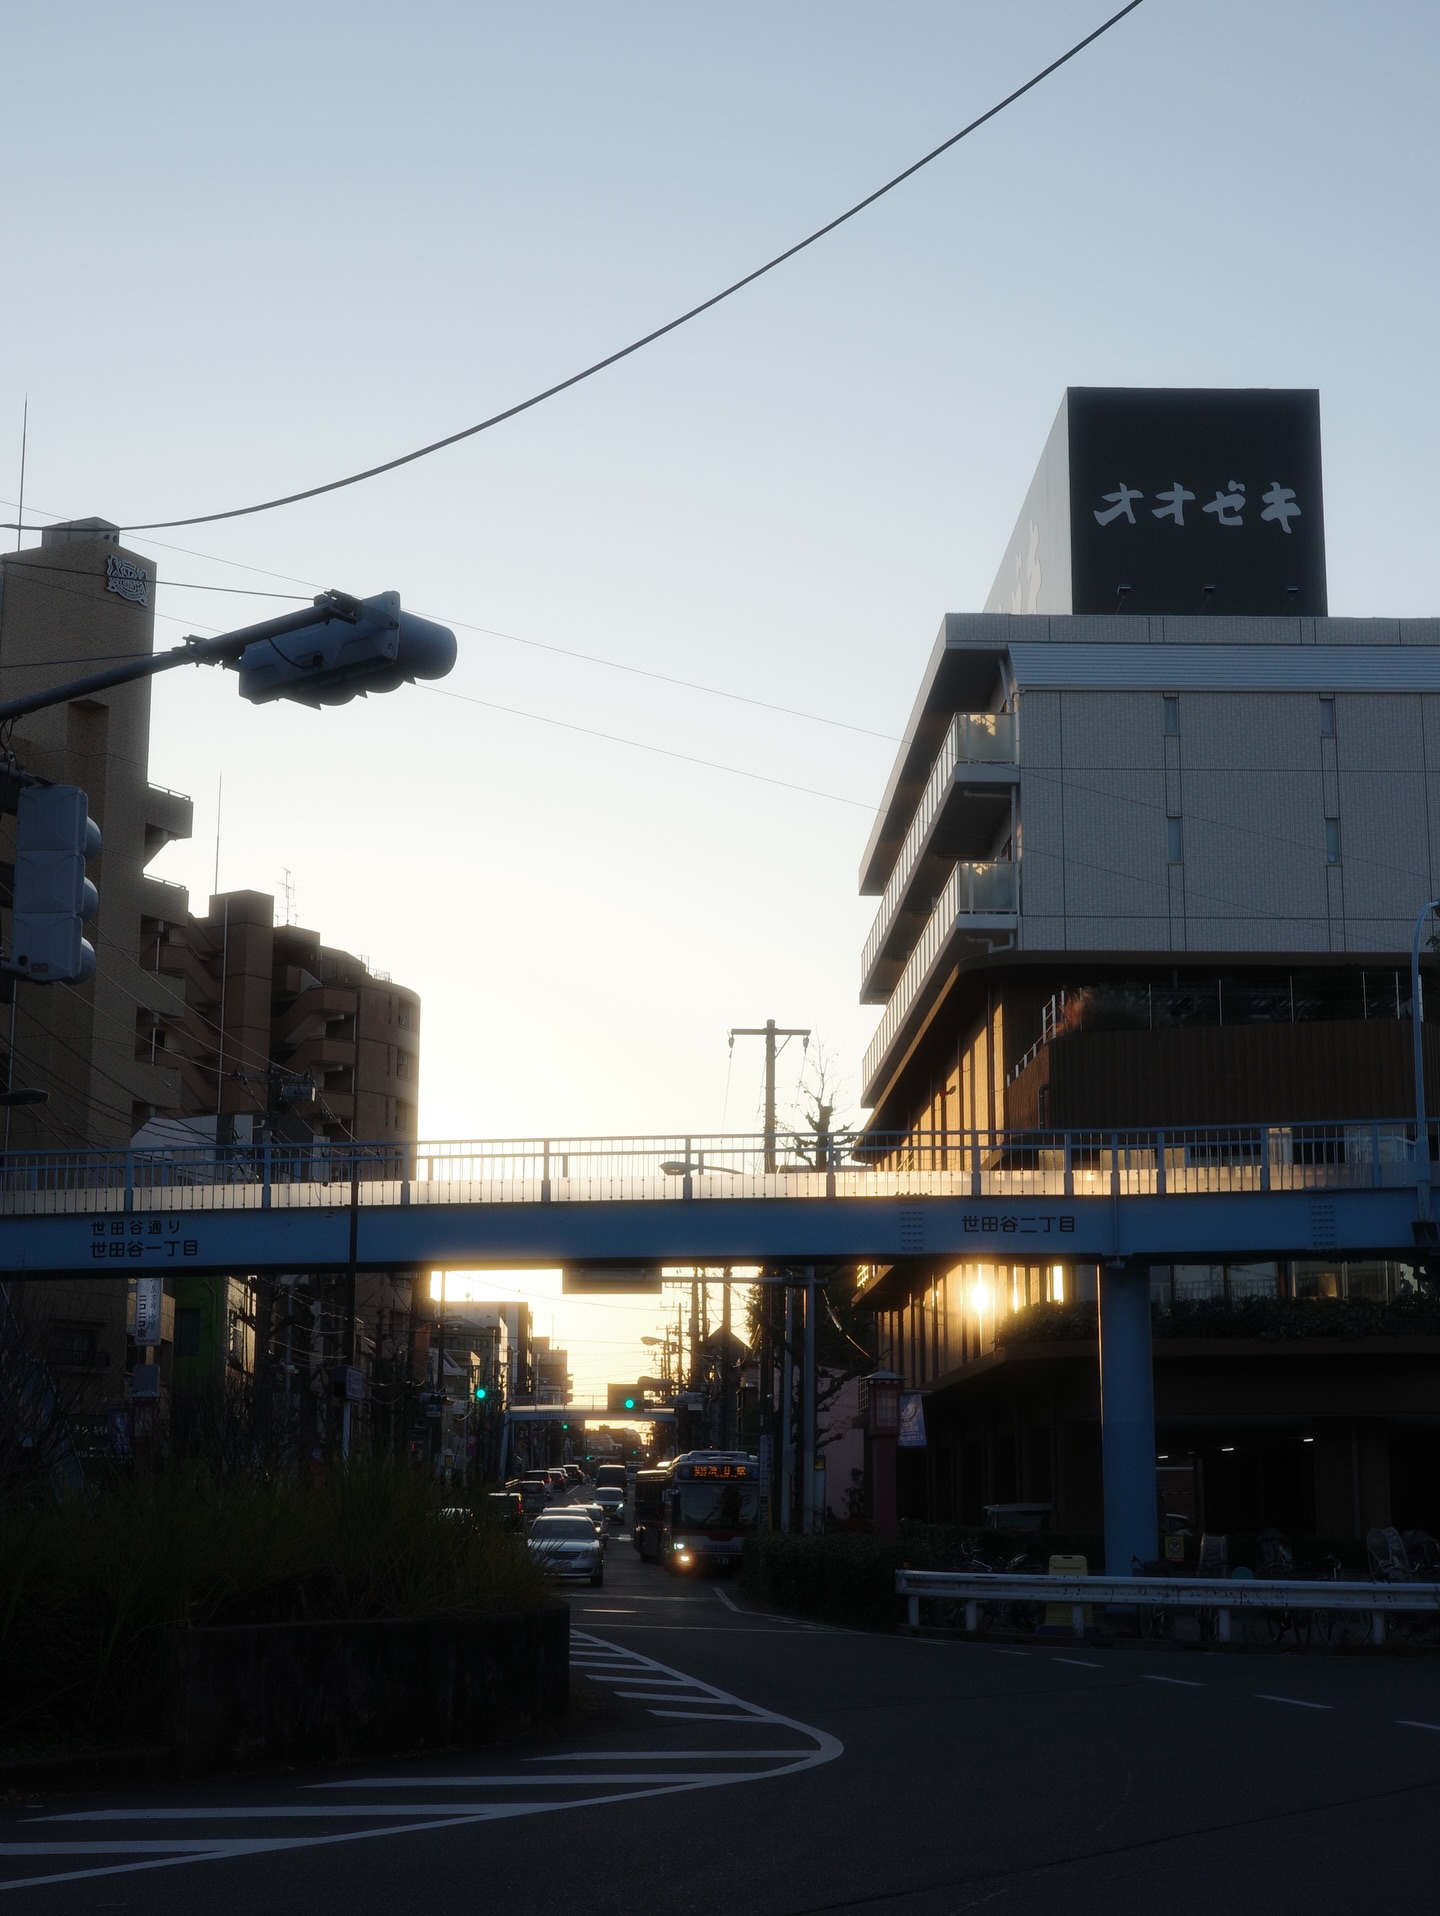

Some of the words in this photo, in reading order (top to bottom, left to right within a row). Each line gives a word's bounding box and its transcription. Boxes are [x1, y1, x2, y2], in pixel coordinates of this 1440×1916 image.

[1093, 479, 1302, 534] オオゼキ
[91, 1220, 180, 1236] 世田谷通り
[961, 1215, 1075, 1233] 世田谷二丁目
[90, 1240, 198, 1259] 世田谷一丁目
